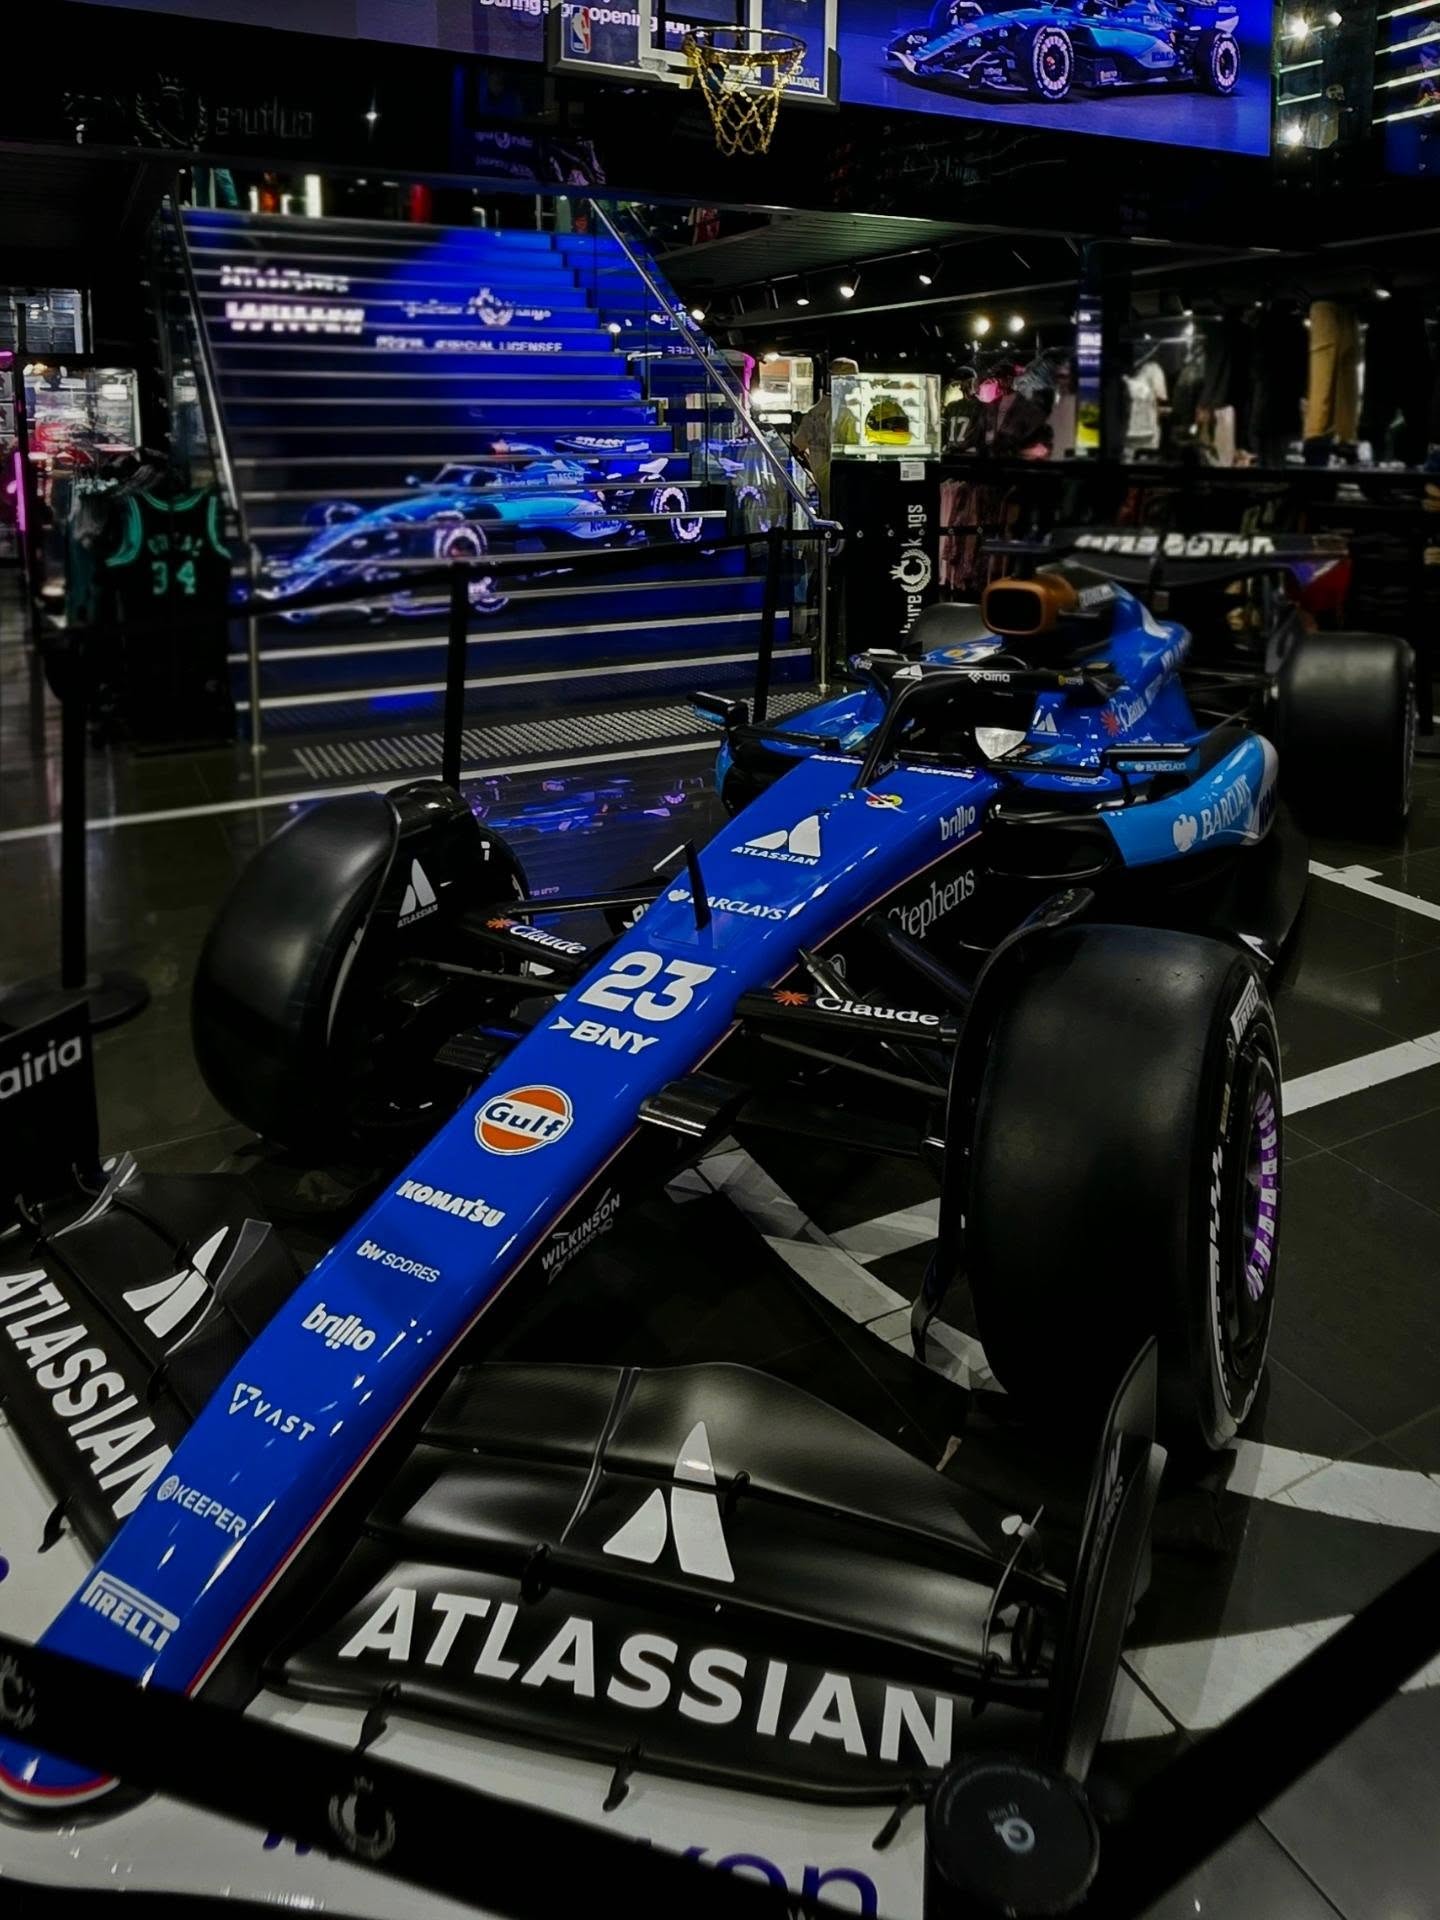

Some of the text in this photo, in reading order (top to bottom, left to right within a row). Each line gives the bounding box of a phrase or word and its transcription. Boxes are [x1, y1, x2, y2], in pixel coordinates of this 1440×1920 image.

[949, 416, 970, 442] 17
[151, 560, 197, 596] 34
[730, 846, 820, 866] ATLASSIAN
[687, 896, 787, 920] ARCLAYS
[509, 924, 587, 955] Claude
[577, 950, 718, 1022] 23
[815, 997, 940, 1026] Claude
[569, 1020, 660, 1055] BNY
[0, 1035, 83, 1101] airia
[485, 1102, 564, 1137] Gulf
[395, 1179, 506, 1228] KOMATSU
[541, 1193, 621, 1271] WILKINSON
[253, 1401, 316, 1441] VAST
[171, 1483, 248, 1539] KEEPER
[79, 1569, 182, 1652] PIRELLI
[337, 1587, 954, 1769] ATLASSIAN
